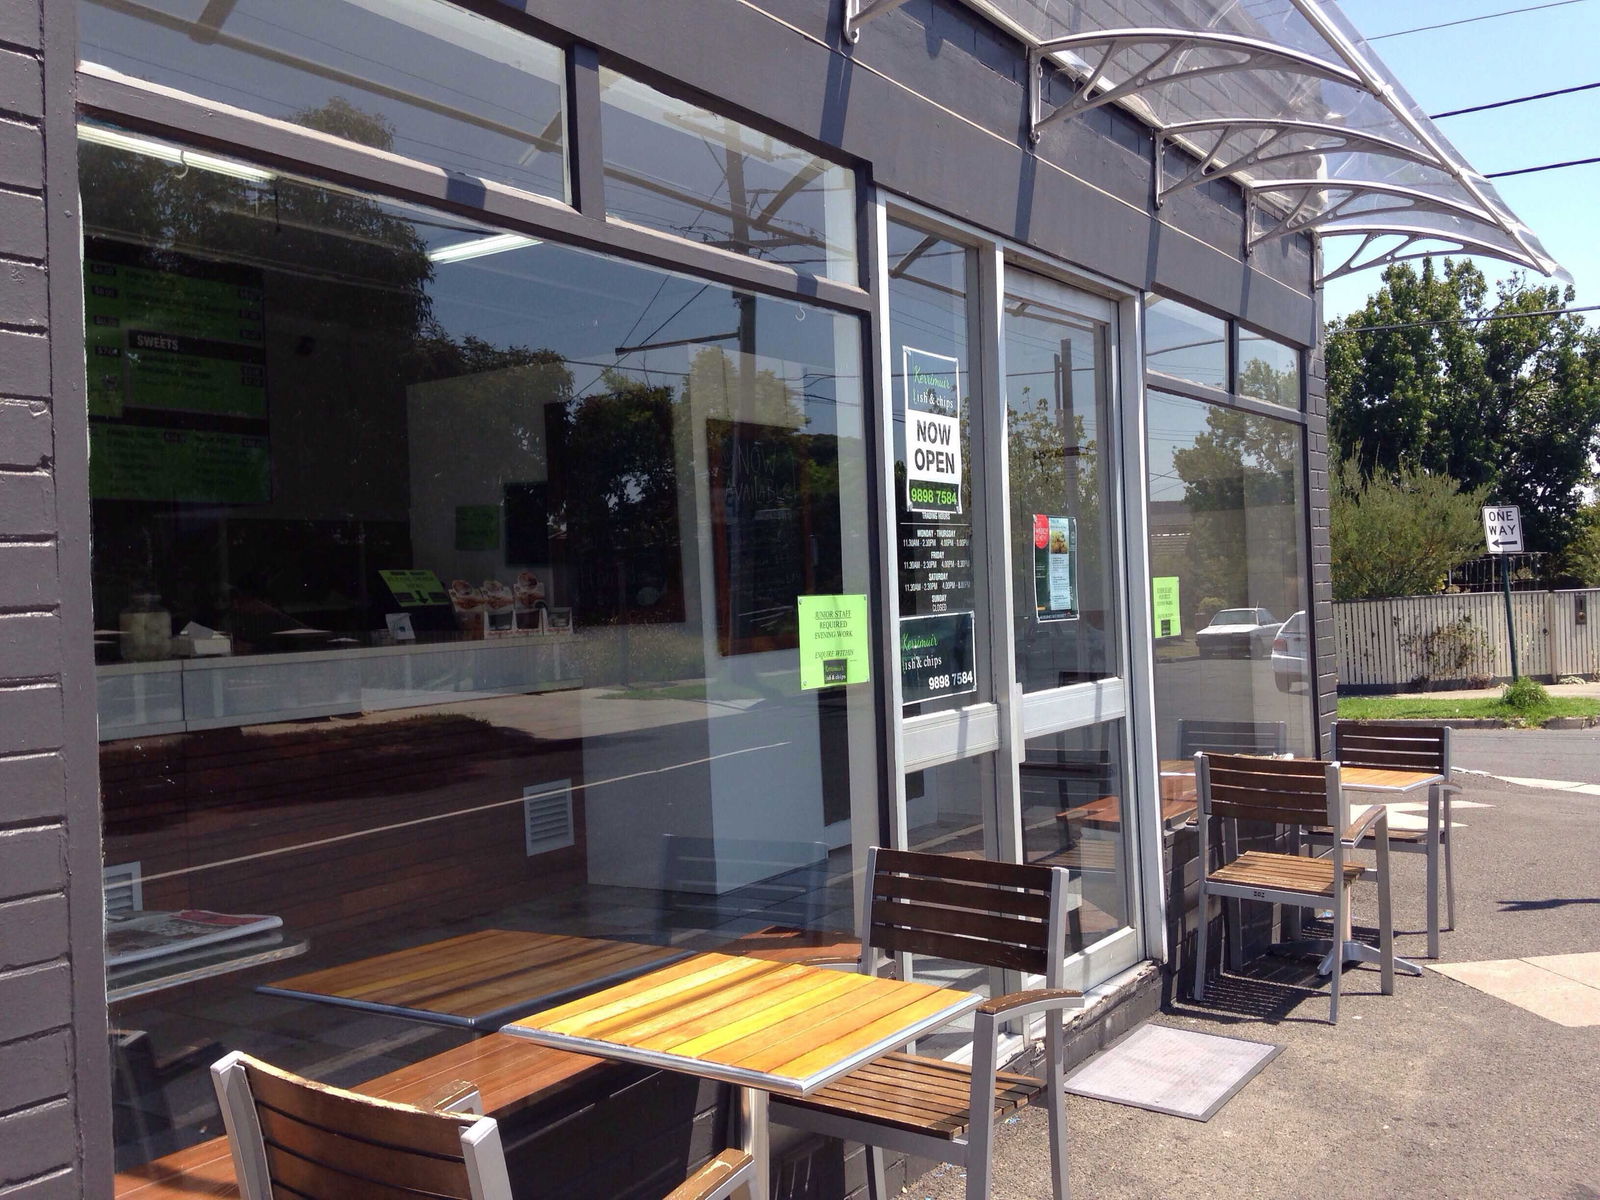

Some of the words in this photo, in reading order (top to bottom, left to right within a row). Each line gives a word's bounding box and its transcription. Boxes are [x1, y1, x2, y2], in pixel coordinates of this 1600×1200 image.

[137, 334, 178, 351] SWEETS
[929, 393, 935, 405] &
[937, 395, 953, 411] chips
[917, 419, 951, 446] NOW
[915, 448, 954, 475] OPEN
[911, 488, 934, 504] 9898
[936, 490, 957, 505] 7584
[1488, 511, 1513, 522] ONE
[1488, 525, 1516, 536] WAY
[931, 551, 944, 559] FRIDAY
[929, 573, 949, 581] SATURDAY
[932, 604, 947, 612] CLOSED
[835, 610, 851, 618] STAFF
[820, 620, 848, 630] REQUIRED
[815, 631, 836, 640] EVENING
[837, 630, 853, 638] WORK
[916, 656, 923, 669] &
[924, 655, 942, 669] chips
[928, 674, 950, 691] 9898
[951, 670, 974, 686] 7584
